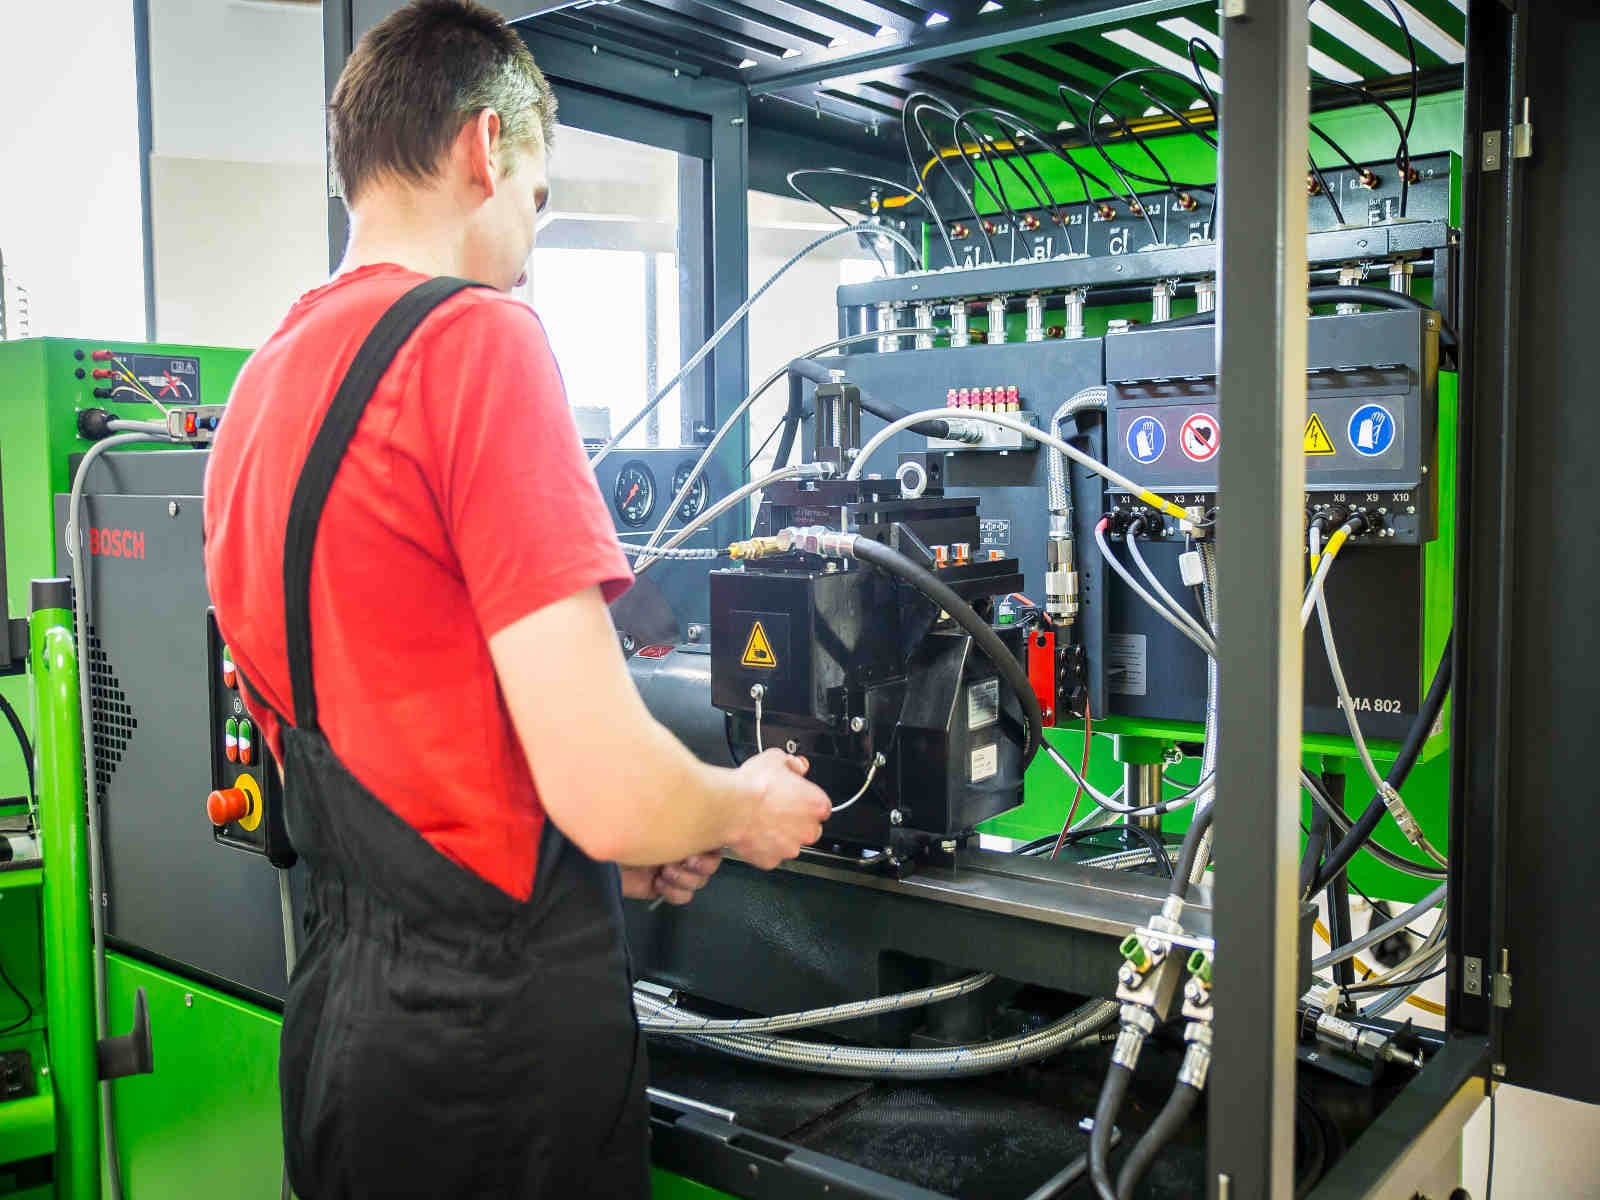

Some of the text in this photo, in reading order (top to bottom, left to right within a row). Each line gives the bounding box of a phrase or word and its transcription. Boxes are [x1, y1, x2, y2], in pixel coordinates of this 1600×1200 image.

[1109, 236, 1122, 255] C
[1174, 495, 1185, 504] X3
[1194, 495, 1205, 503] X4
[1333, 493, 1346, 503] X8
[1366, 493, 1379, 503] X9
[1392, 493, 1409, 503] X10
[90, 527, 145, 560] BOSCH
[1374, 699, 1401, 714] 802
